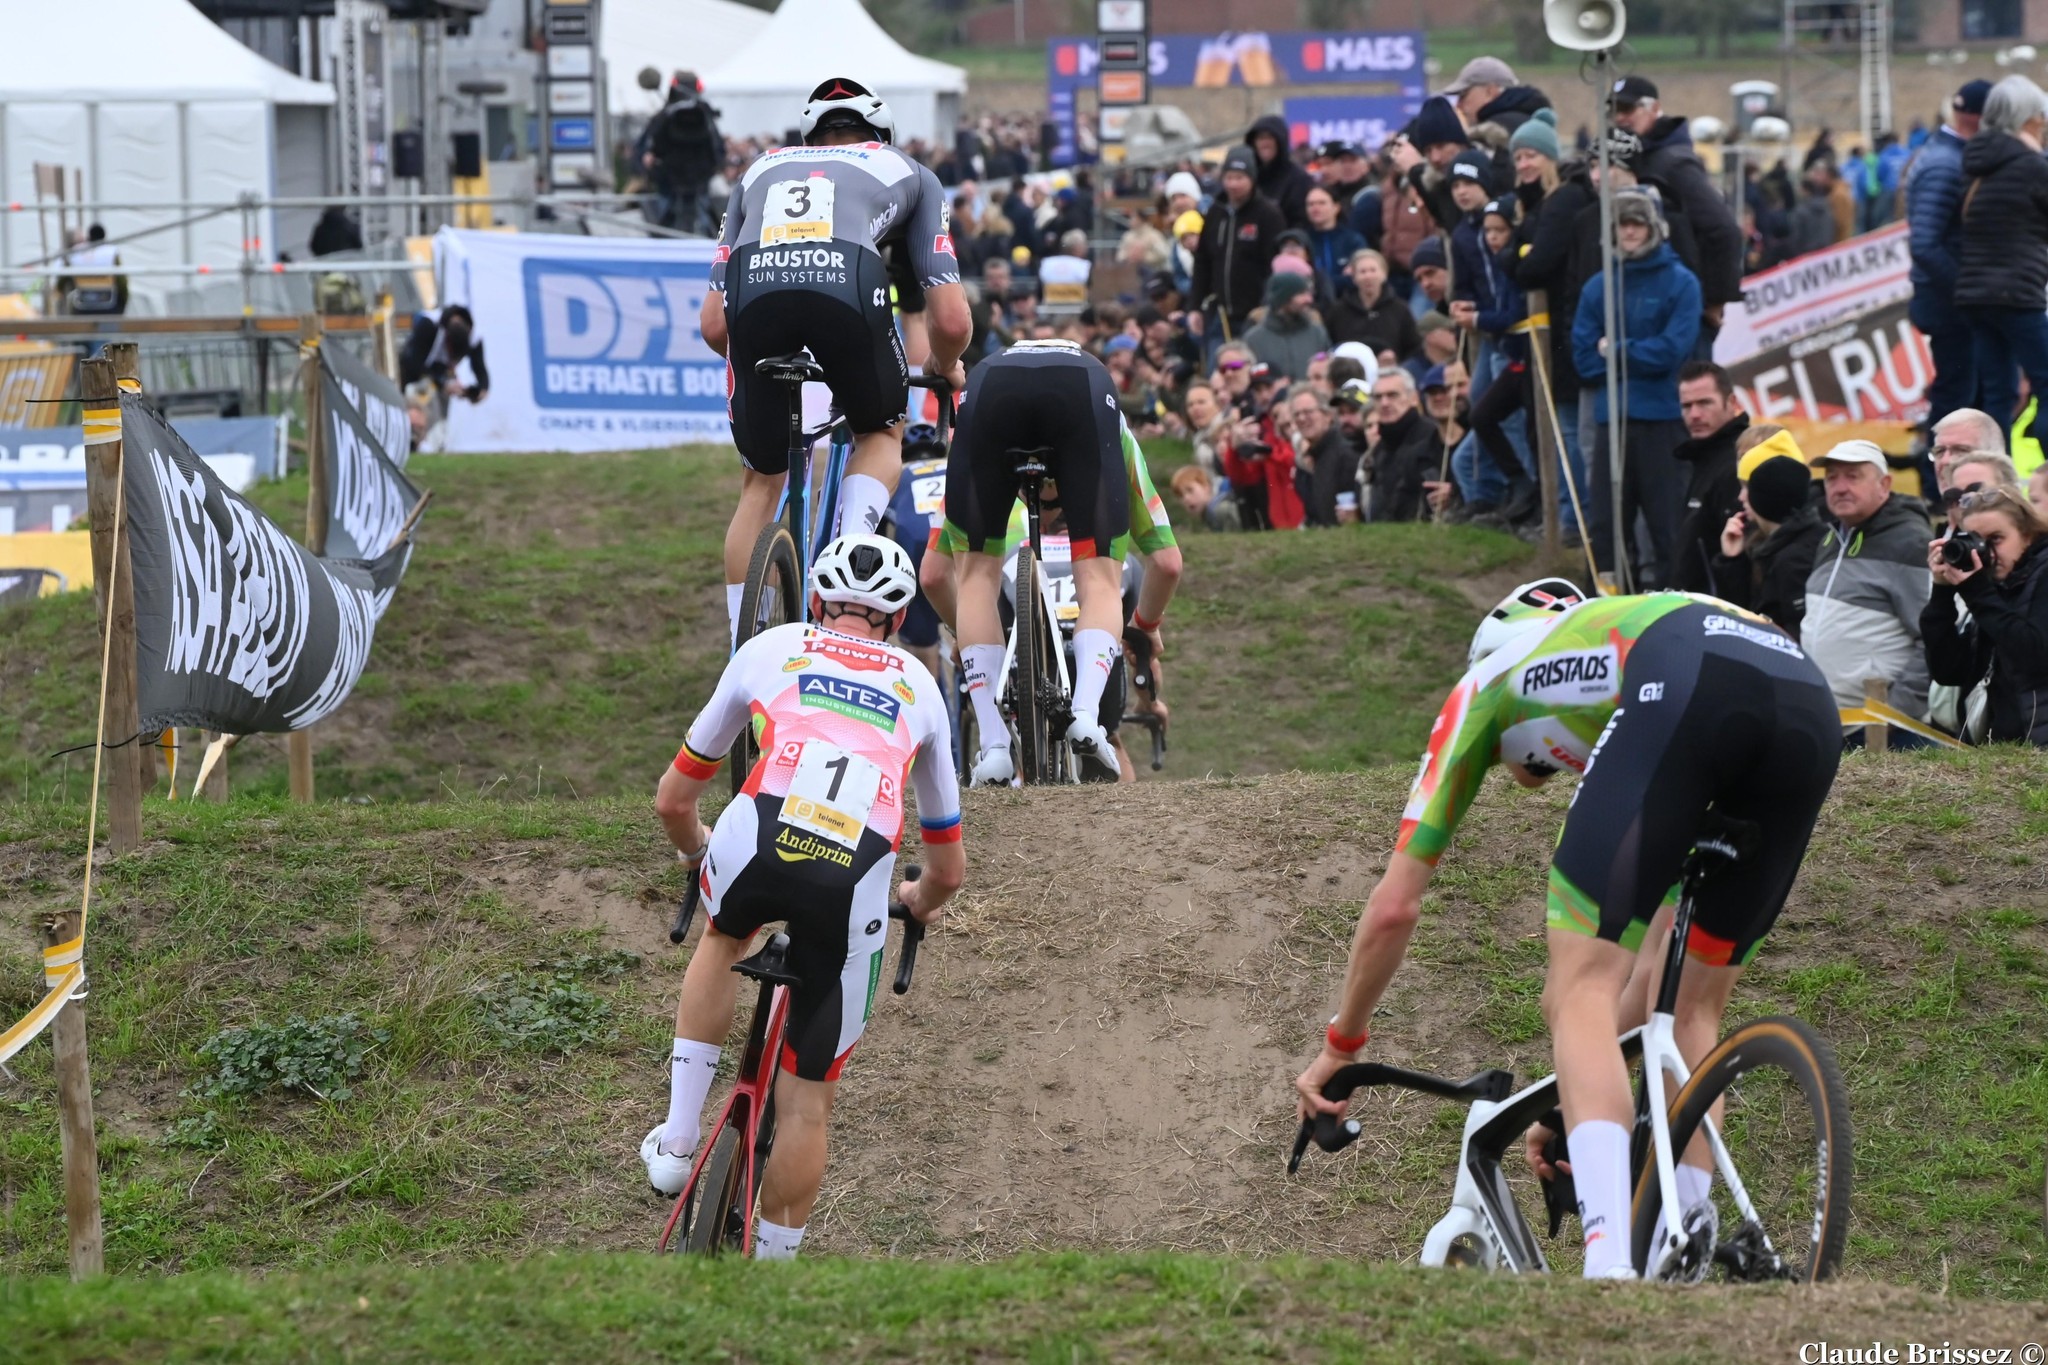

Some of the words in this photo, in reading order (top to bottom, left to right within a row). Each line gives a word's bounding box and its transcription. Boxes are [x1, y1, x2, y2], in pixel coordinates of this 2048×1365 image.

[1324, 36, 1415, 72] MAES
[784, 185, 811, 218] 3
[749, 248, 846, 270] BRUSTOR
[748, 271, 775, 284] SUN
[781, 271, 847, 284] SYSTEMS
[545, 364, 677, 395] DEFRAEYE
[811, 641, 899, 667] Pauwels
[1523, 655, 1611, 695] FRISTADS
[804, 678, 895, 717] ALTEZ
[805, 697, 891, 728] INDUSTRIEBOUW
[825, 755, 850, 802] 1
[818, 813, 845, 829] telenet
[775, 827, 853, 868] Andiprim
